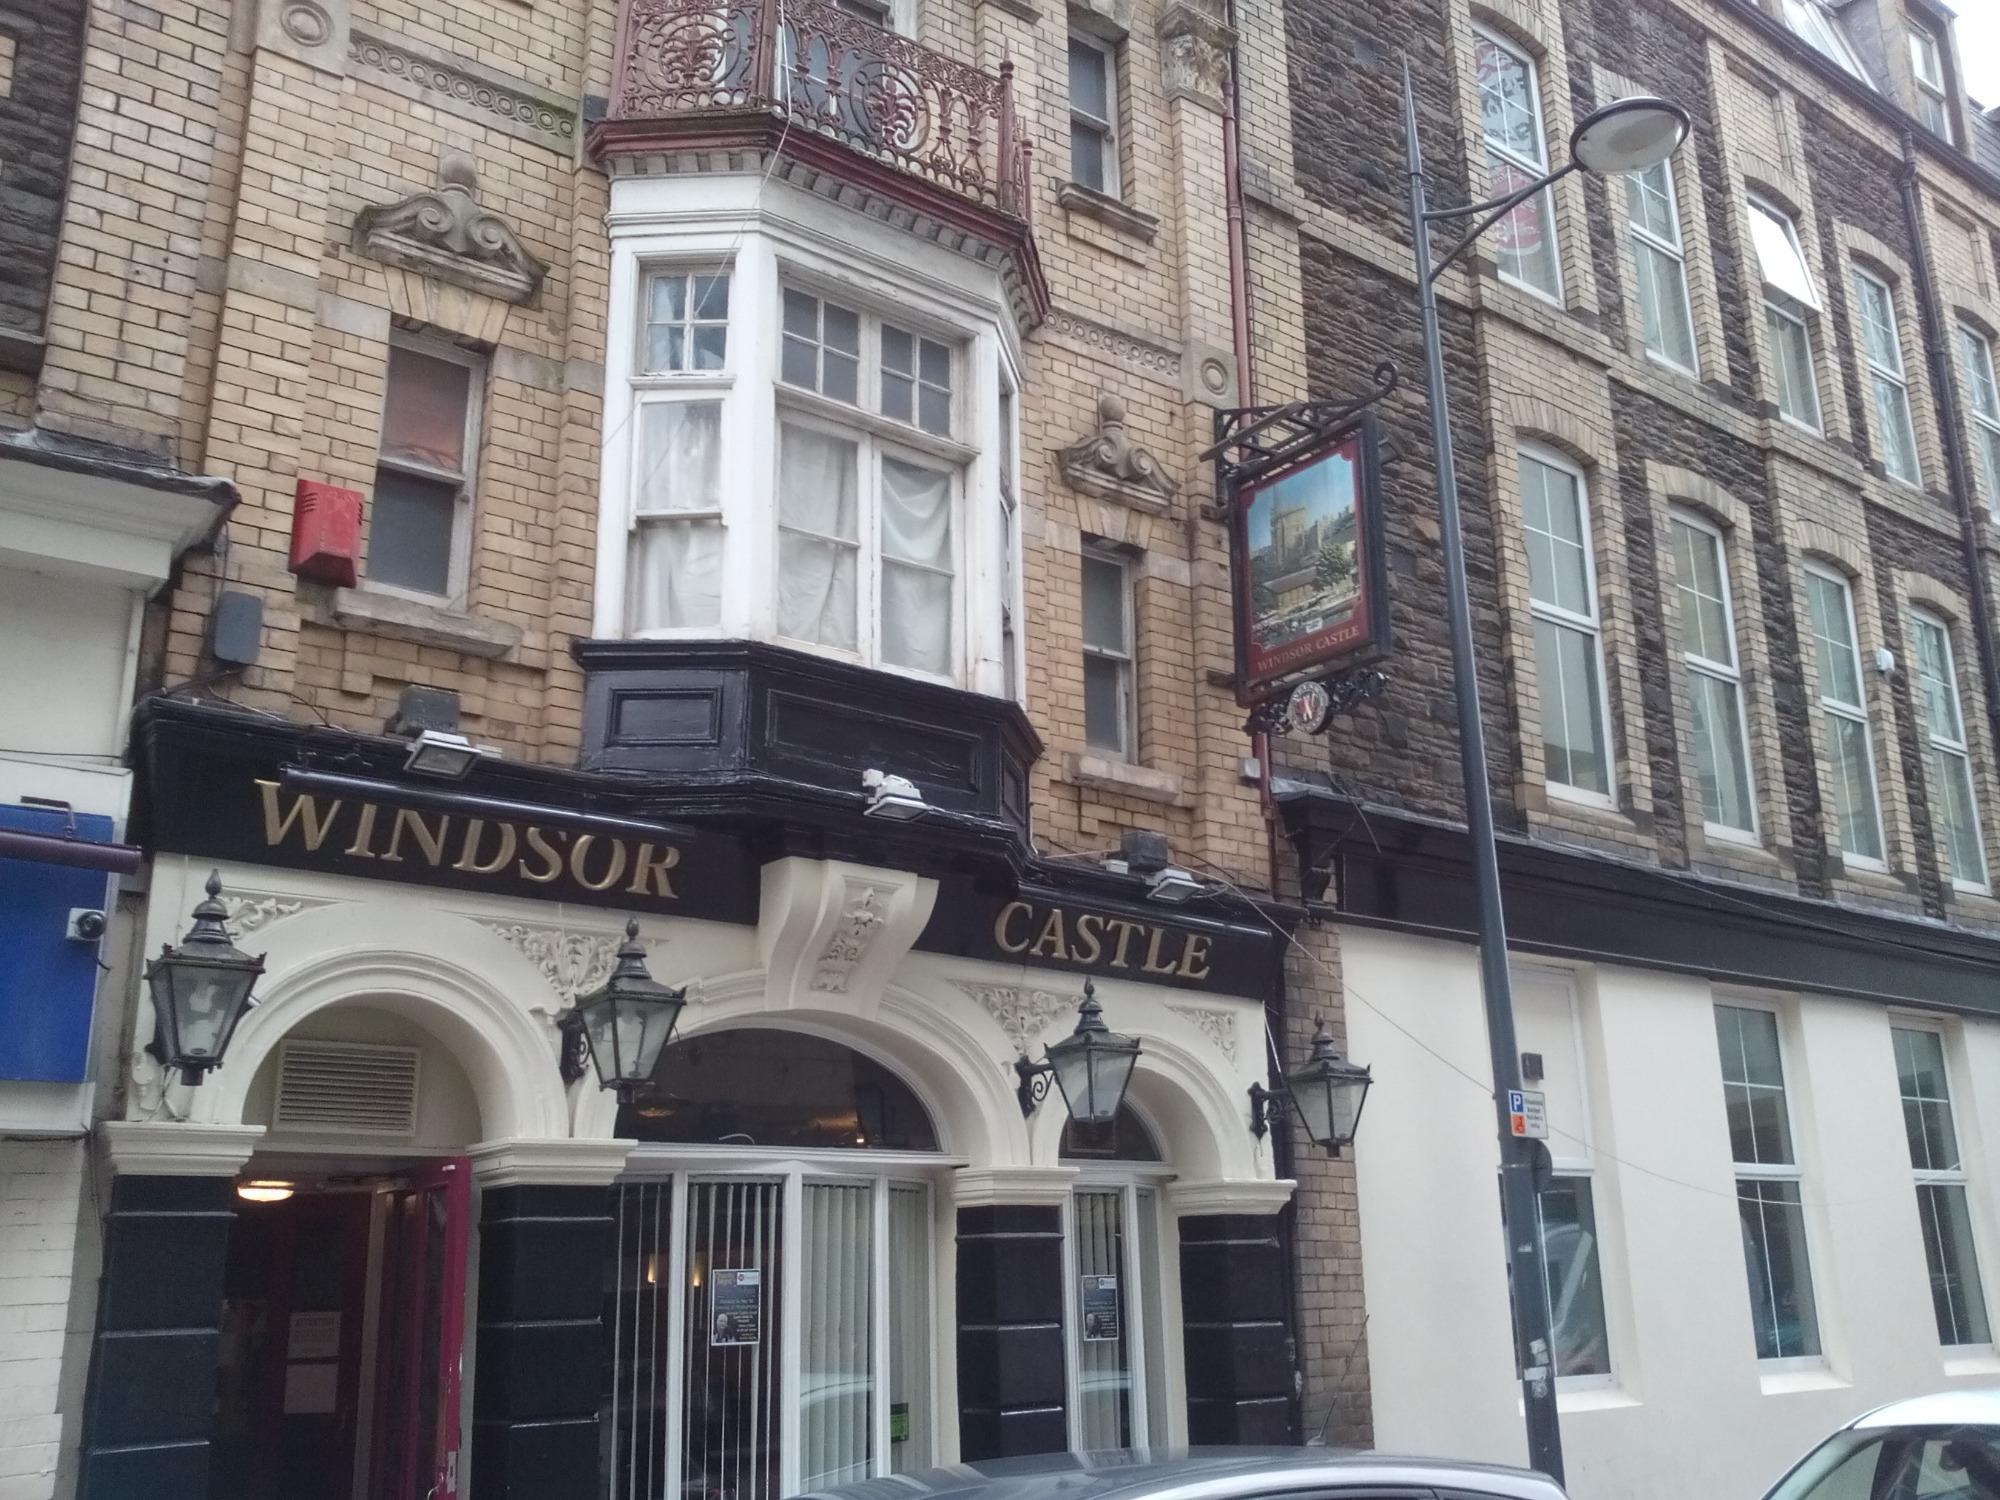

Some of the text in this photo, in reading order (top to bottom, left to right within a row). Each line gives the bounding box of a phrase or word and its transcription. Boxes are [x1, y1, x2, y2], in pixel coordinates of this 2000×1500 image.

[1257, 625, 1360, 671] WINDSOR CASTLE
[254, 778, 1213, 980] WINDSOR CASTLE
[1513, 1094, 1521, 1110] P
